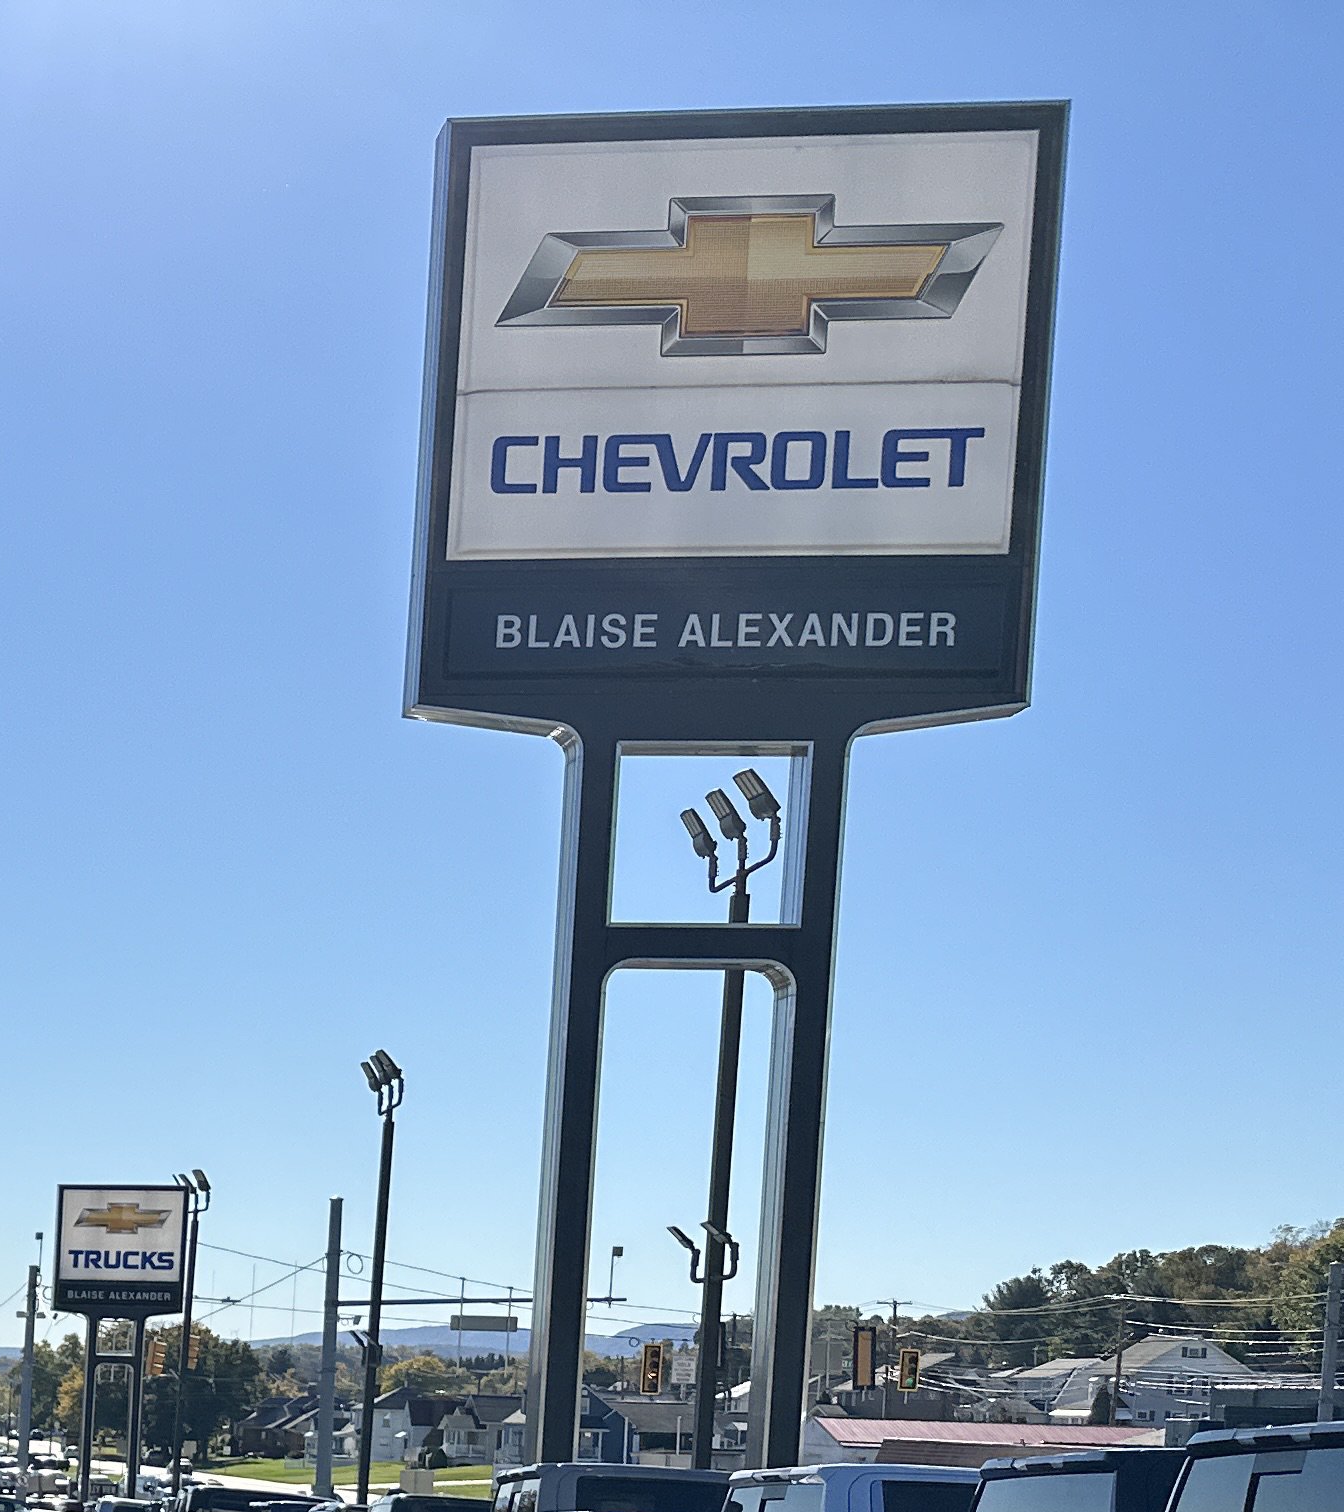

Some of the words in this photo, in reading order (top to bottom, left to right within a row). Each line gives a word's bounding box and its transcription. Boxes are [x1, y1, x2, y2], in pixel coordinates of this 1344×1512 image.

[490, 426, 985, 494] CHEVROLET
[495, 613, 658, 648] BLAISE
[678, 611, 957, 648] ALEXANDER
[68, 1249, 175, 1271] TRUCKS
[67, 1289, 105, 1300] BLAISE
[108, 1290, 171, 1301] ALEXANDER
